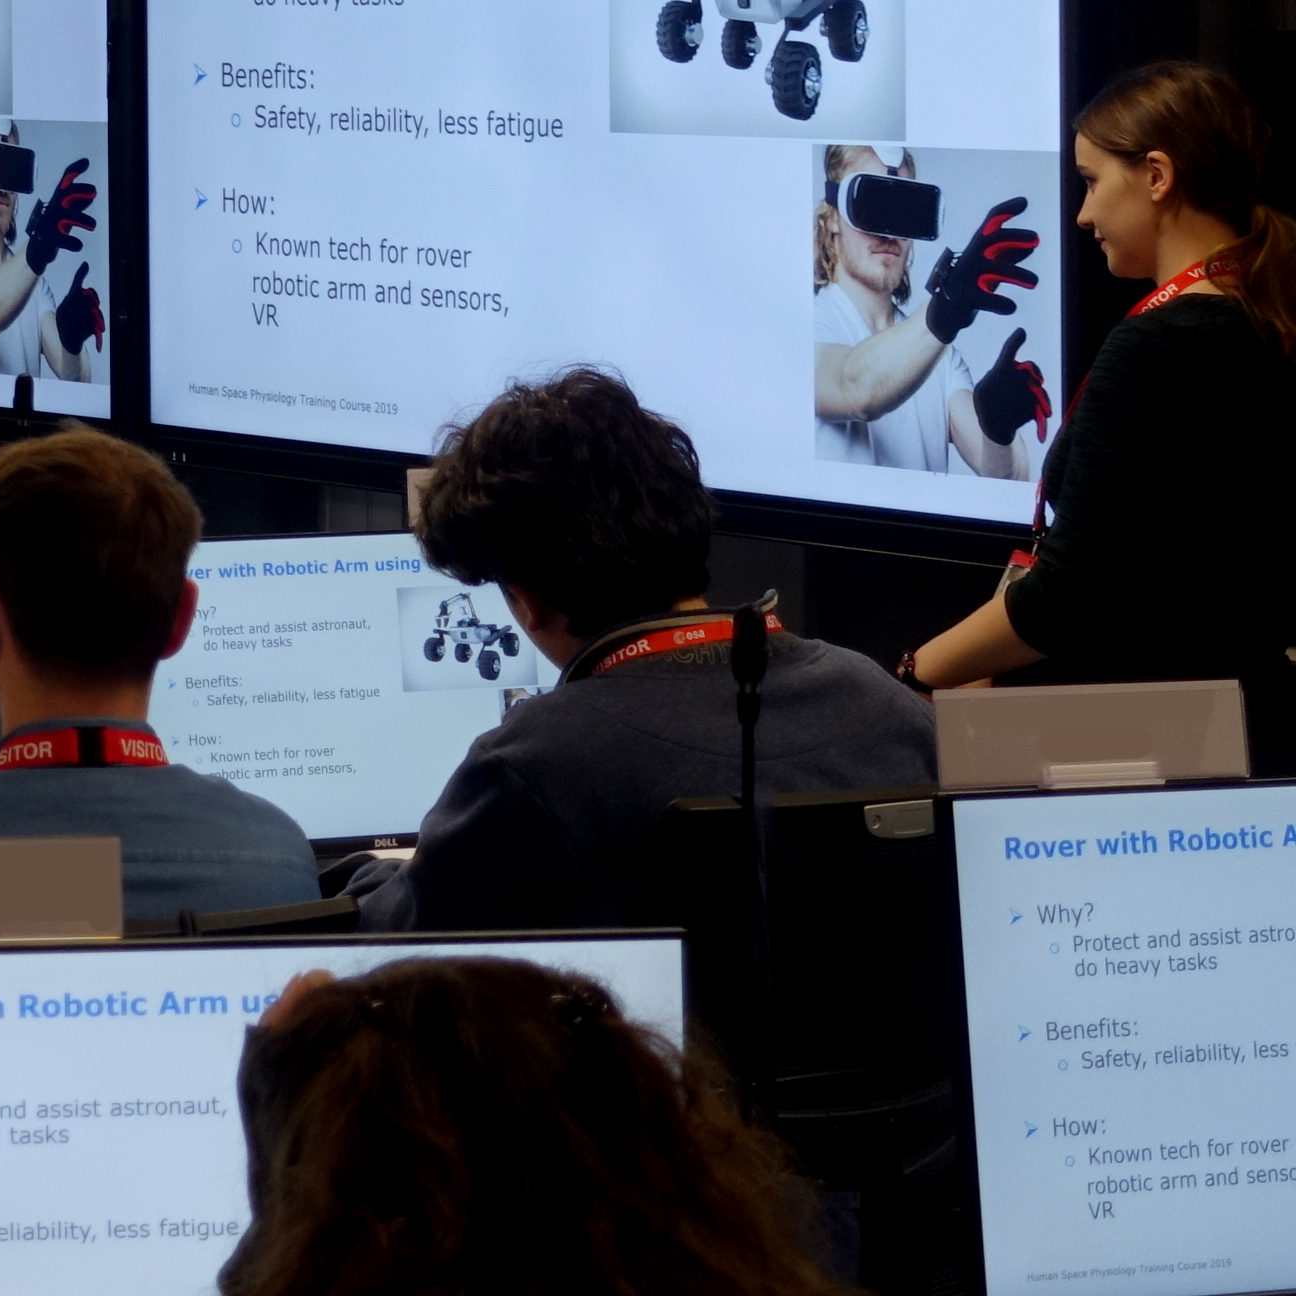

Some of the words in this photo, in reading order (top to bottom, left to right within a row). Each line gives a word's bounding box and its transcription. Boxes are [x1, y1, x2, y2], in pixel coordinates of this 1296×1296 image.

[221, 61, 314, 89] Benefits:
[254, 104, 321, 135] Safety,
[330, 106, 428, 139] reliability,
[438, 108, 478, 135] less
[486, 109, 563, 143] fatigue
[222, 187, 274, 215] How:
[256, 231, 320, 258] Known
[328, 236, 371, 261] tech
[379, 237, 409, 264] for
[416, 246, 472, 268] rover
[252, 270, 319, 298] robotic
[326, 280, 366, 301] arm
[374, 279, 411, 305] and
[420, 287, 509, 317] sensors,
[251, 302, 279, 327] VR
[188, 382, 219, 396] Human
[221, 385, 247, 399] Space
[250, 388, 297, 406] Physiology
[299, 393, 336, 411] Training
[339, 397, 371, 412] Course
[374, 401, 398, 415] 2019
[686, 629, 705, 640] esa
[374, 838, 398, 848] DELL
[1004, 836, 1086, 860] Rover
[1096, 829, 1157, 855] with
[1168, 824, 1273, 852] Robotic
[18, 991, 147, 1018] Robotic
[158, 990, 228, 1015] Arm
